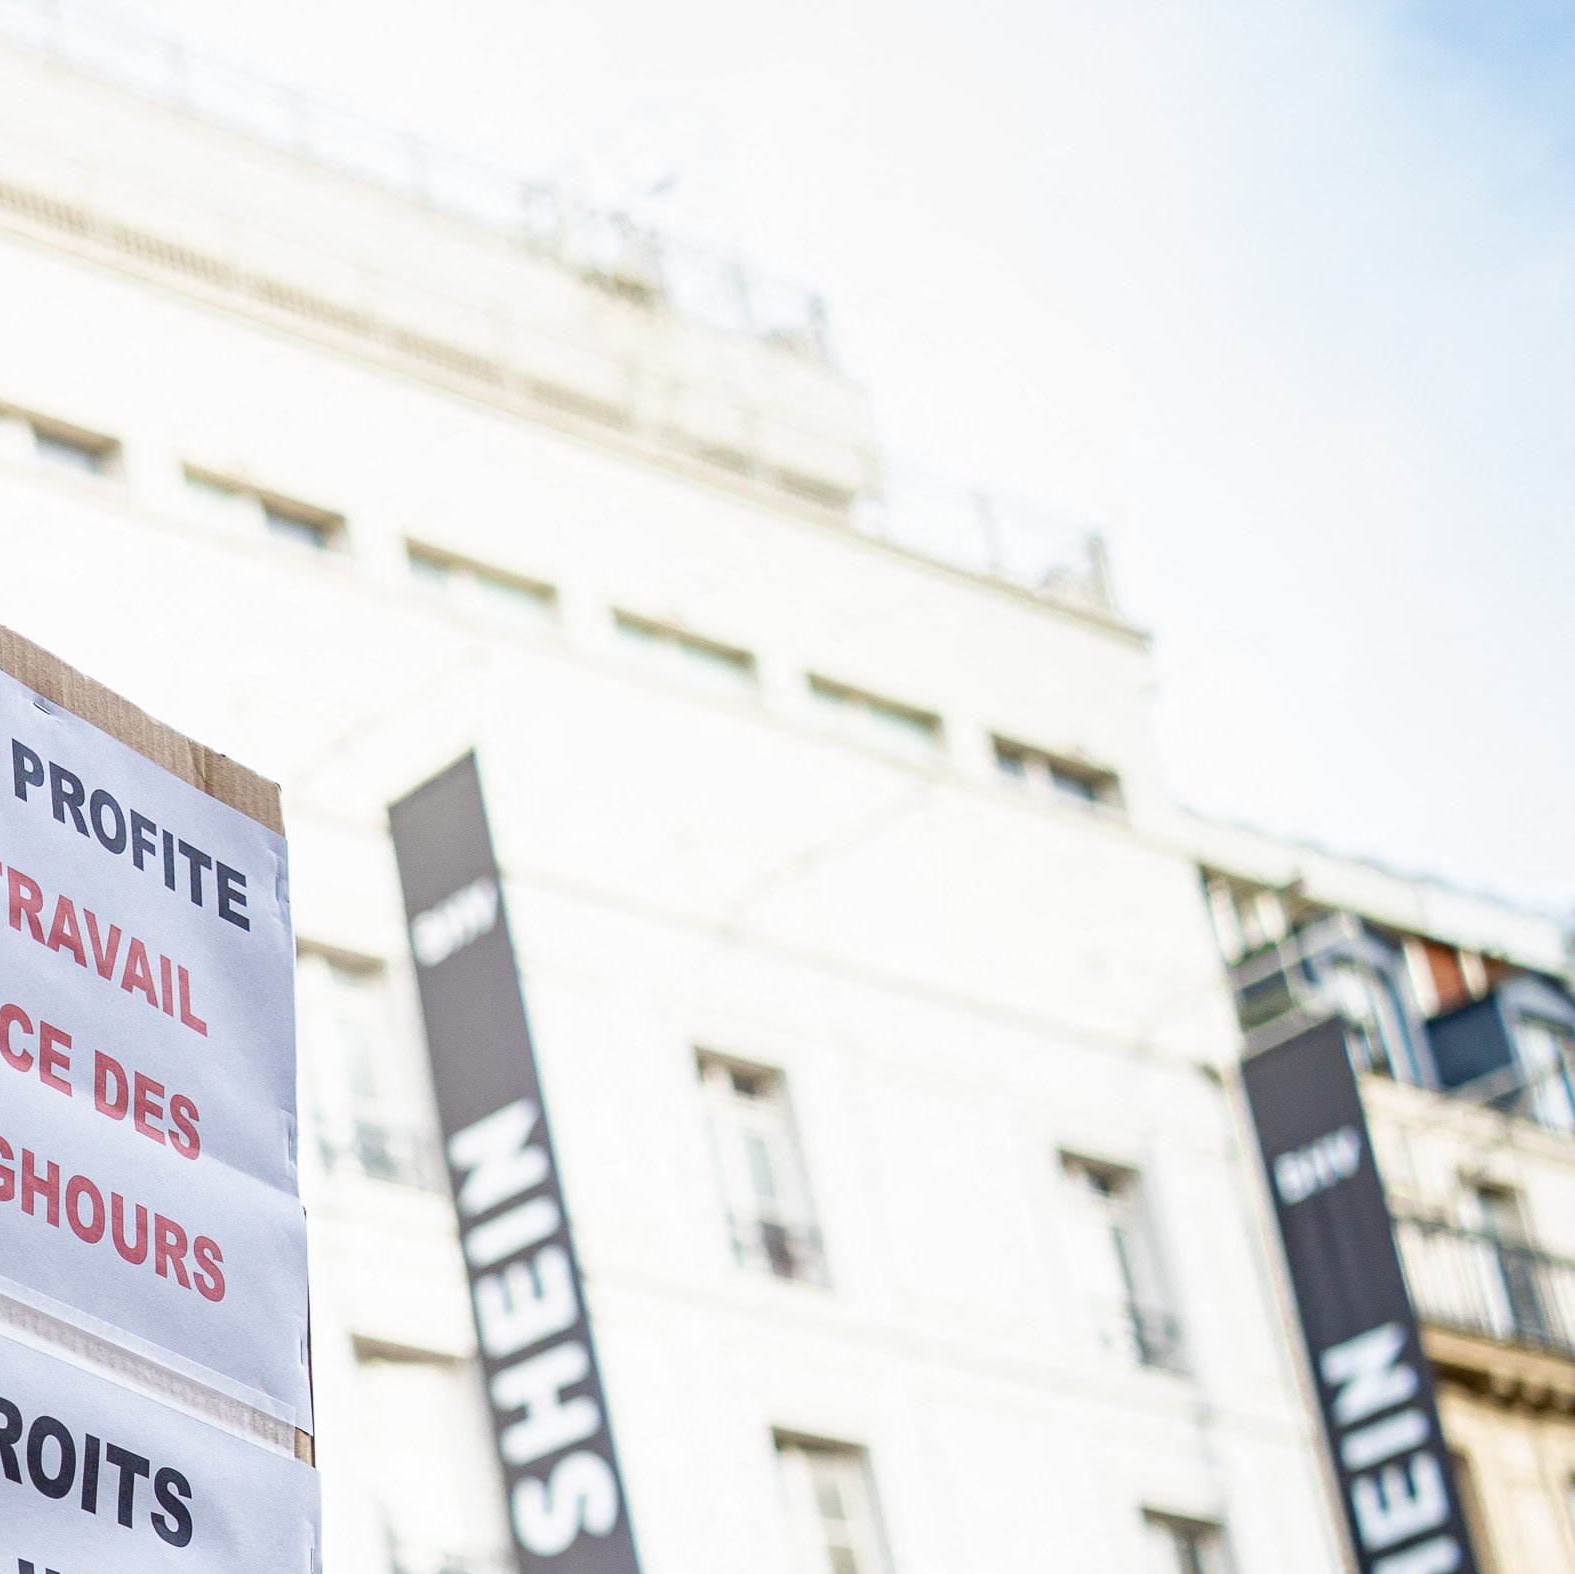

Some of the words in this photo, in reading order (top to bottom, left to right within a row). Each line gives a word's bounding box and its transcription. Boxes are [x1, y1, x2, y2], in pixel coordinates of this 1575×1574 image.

[11, 737, 251, 932] PROFITE
[94, 1051, 200, 1159] DES
[449, 1099, 619, 1555] SHEIN
